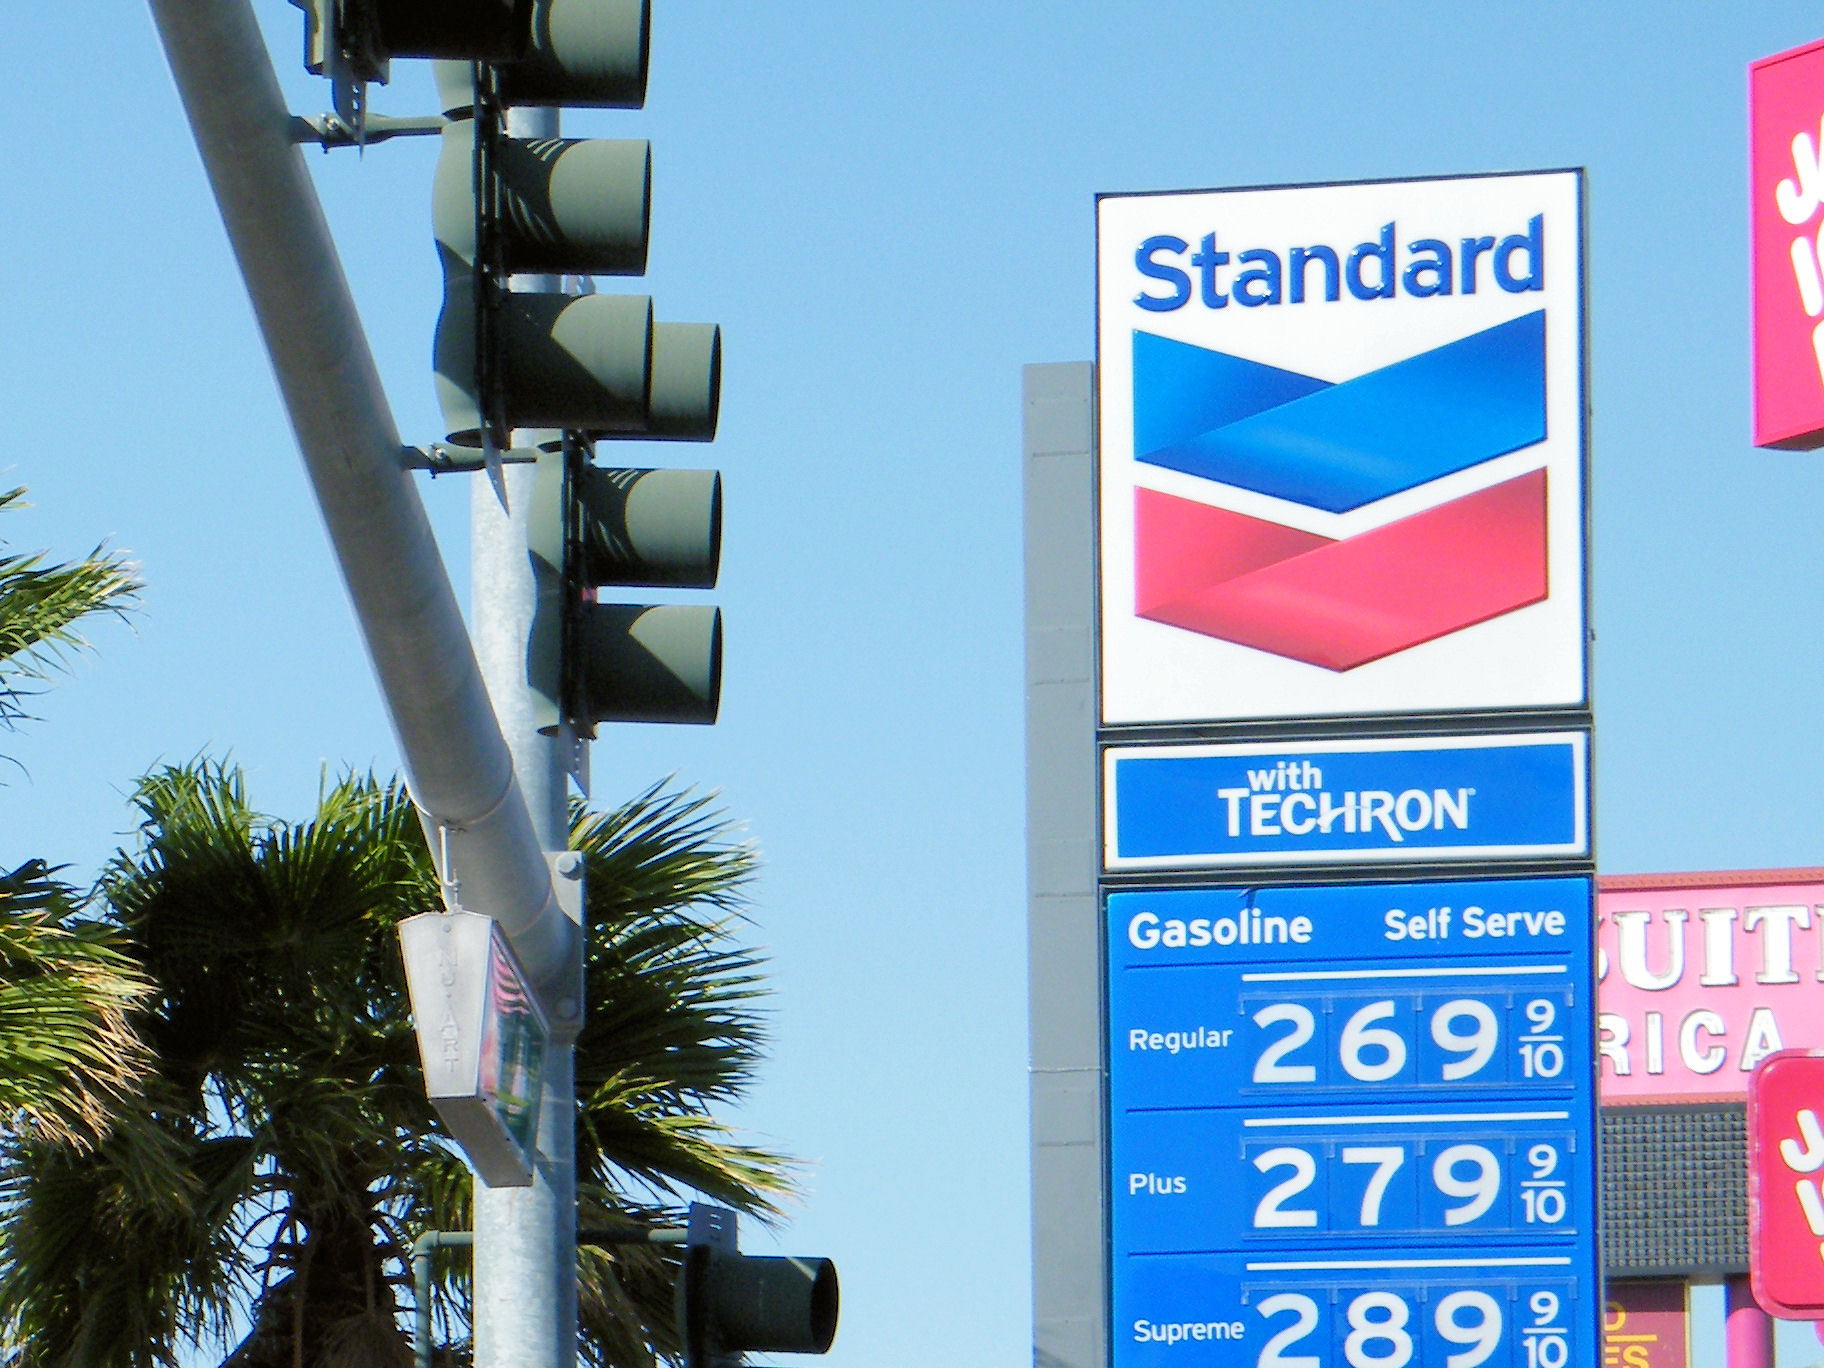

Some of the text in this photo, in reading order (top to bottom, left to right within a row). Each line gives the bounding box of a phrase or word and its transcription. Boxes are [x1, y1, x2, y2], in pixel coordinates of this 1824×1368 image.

[1132, 212, 1544, 313] Standard
[1247, 761, 1322, 791] with
[1217, 788, 1472, 842] TECHRON
[1128, 908, 1313, 949] Gasoline
[1384, 906, 1566, 941] Self Serve
[1599, 905, 1824, 991] UIT
[1129, 998, 1499, 1083] Regular 269
[1129, 1144, 1501, 1229] Plus 279
[1133, 1319, 1246, 1345] Supreme
